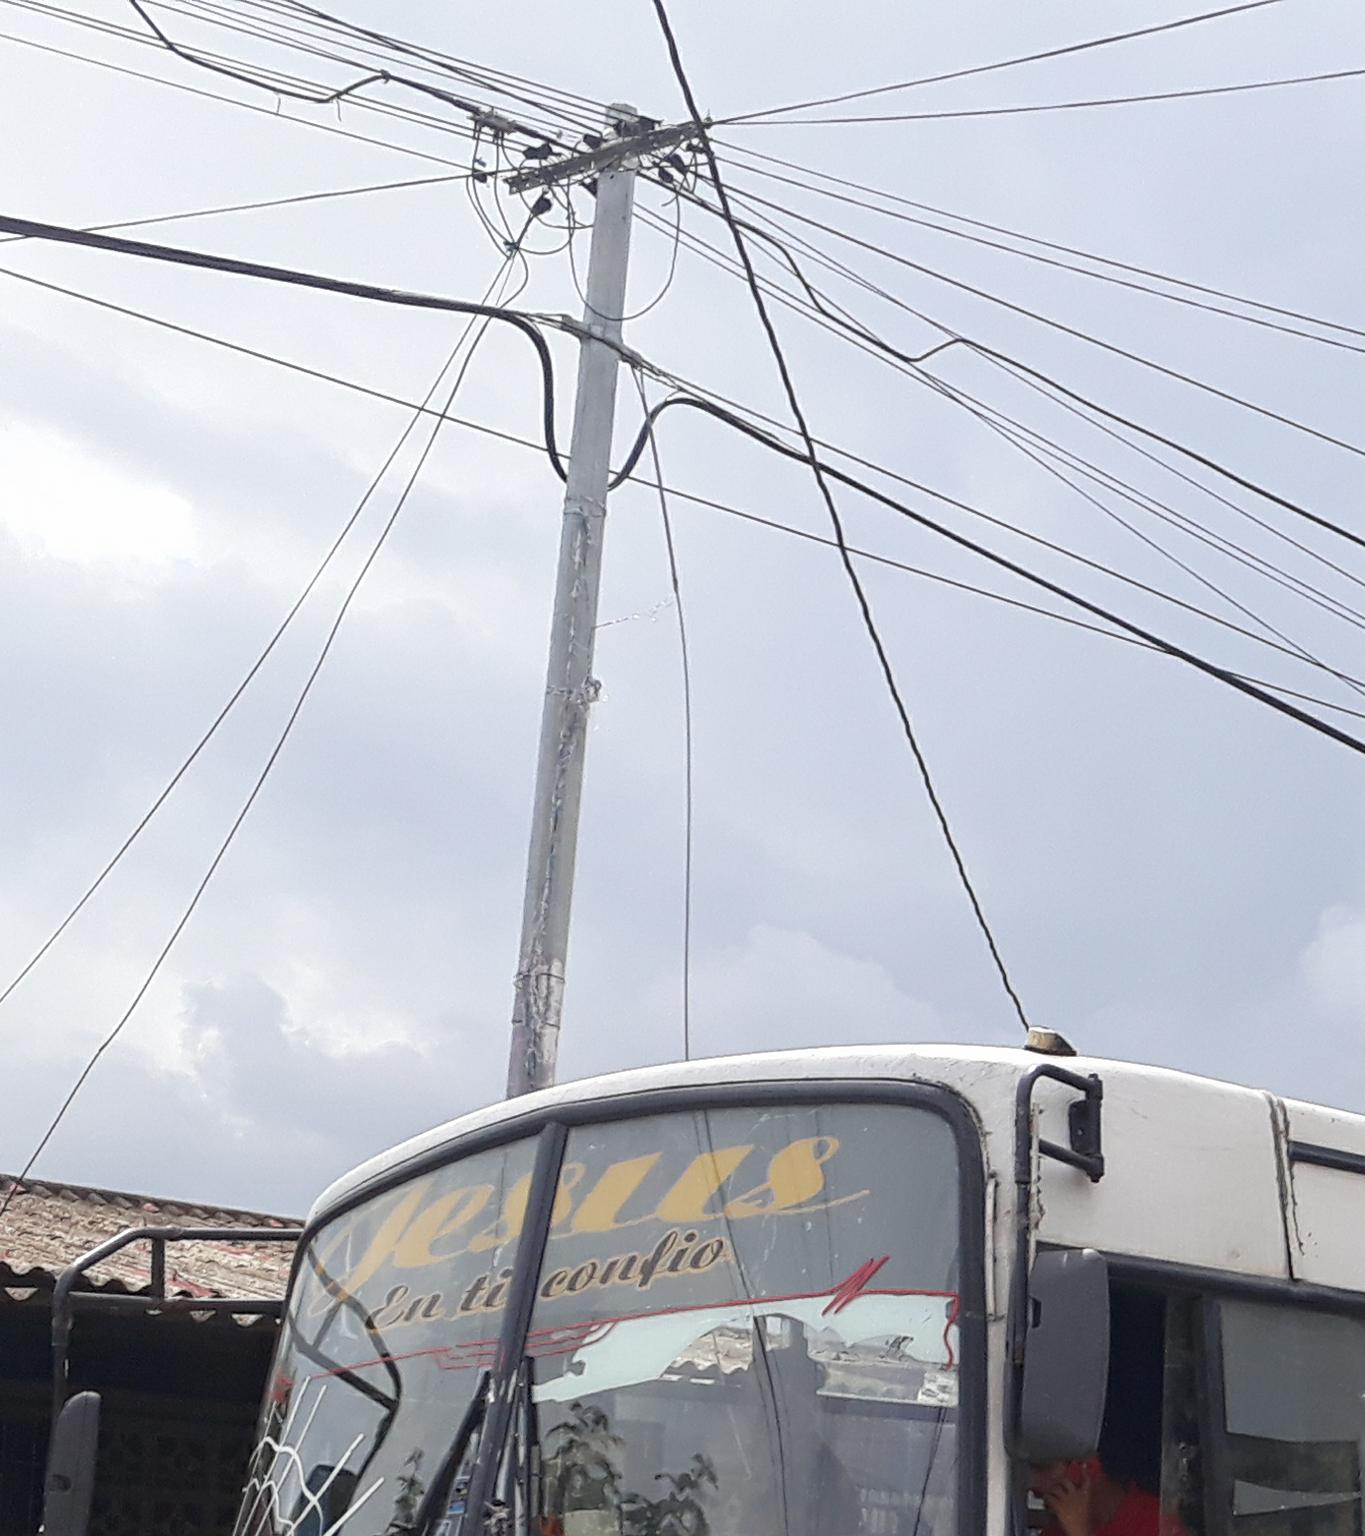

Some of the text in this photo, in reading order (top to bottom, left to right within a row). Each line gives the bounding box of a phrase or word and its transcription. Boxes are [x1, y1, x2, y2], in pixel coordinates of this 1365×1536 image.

[368, 1229, 730, 1332] En ti confio
